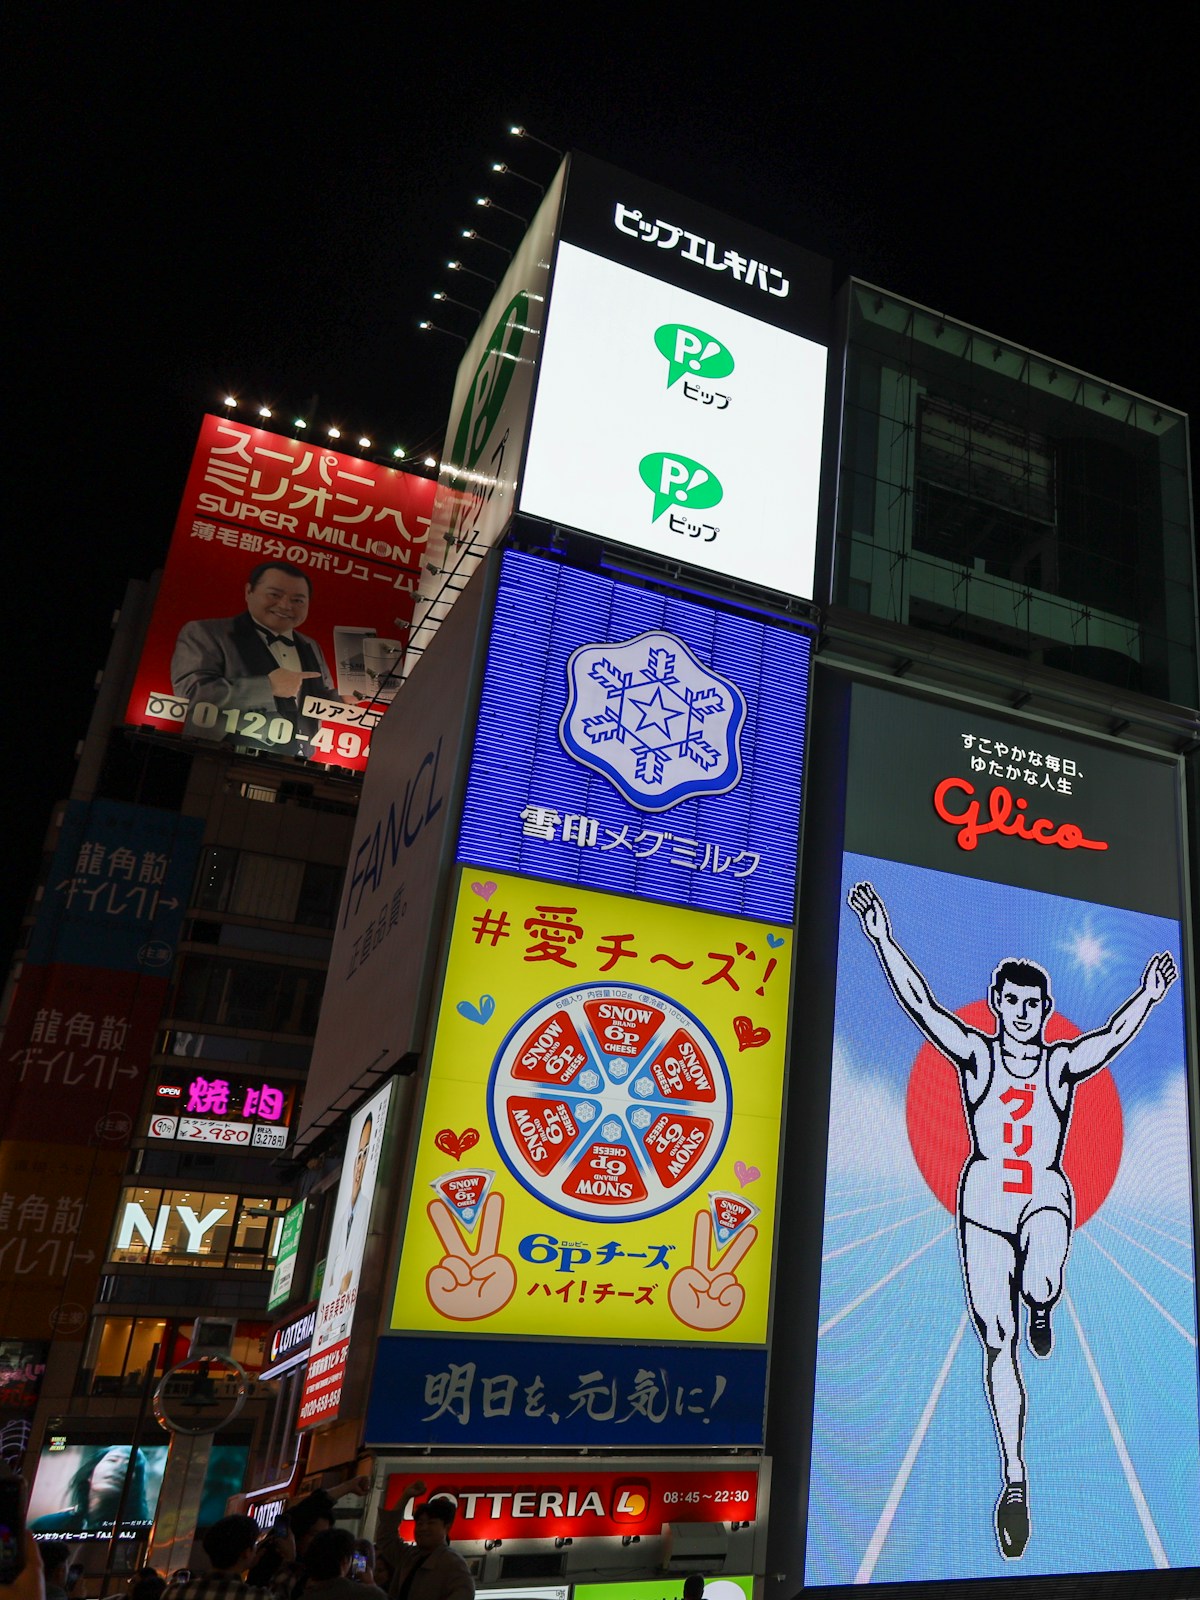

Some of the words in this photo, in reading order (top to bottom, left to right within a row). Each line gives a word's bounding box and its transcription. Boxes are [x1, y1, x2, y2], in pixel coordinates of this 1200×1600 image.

[614, 203, 789, 298] ピップエレキバン
[684, 381, 732, 410] ピップ
[210, 426, 375, 488] スーパー
[196, 493, 299, 533] SUPER
[306, 522, 412, 569] MILLION
[669, 514, 720, 542] ピップ
[190, 520, 421, 594] 薄毛部分のボリューム
[192, 702, 371, 759] 0120-49
[961, 732, 1085, 779] すこやかな毎日、
[970, 755, 1074, 796] ゆたかな人生
[343, 734, 444, 931] FANCL
[934, 777, 1109, 851] Glico
[519, 803, 761, 879] 雪印メグミルク
[75, 841, 169, 885] 龍角散
[55, 876, 161, 922] ダイレクト
[30, 1008, 128, 1052] 龍角散
[597, 1003, 654, 1025] SNOW
[521, 1019, 564, 1071] SNOW
[603, 1025, 640, 1046] 6P
[604, 1043, 638, 1055] CHEESE
[544, 1044, 576, 1076] 6P
[559, 1053, 586, 1083] CHEESE
[664, 1056, 685, 1092] 6P
[677, 1041, 712, 1092] SNOW
[159, 1087, 181, 1097] OPEN
[186, 1075, 284, 1121] 焼肉
[652, 1063, 672, 1096] CHEESE
[511, 1108, 549, 1163] SNOW
[543, 1108, 564, 1145] 6P
[555, 1103, 577, 1137] CHEESE
[644, 1115, 670, 1146] CHEESE
[656, 1122, 684, 1155] 6P
[592, 1145, 628, 1158] CHEESE
[666, 1126, 706, 1180] SNOW
[998, 1083, 1037, 1195] グリコ
[448, 1177, 480, 1191] SNOW
[589, 1155, 628, 1177] 6P
[454, 1190, 477, 1202] 6P
[574, 1179, 634, 1199] SNOW
[719, 1199, 747, 1215] SNOW
[720, 1210, 739, 1223] 6P
[279, 1311, 317, 1354] LOTTERIA
